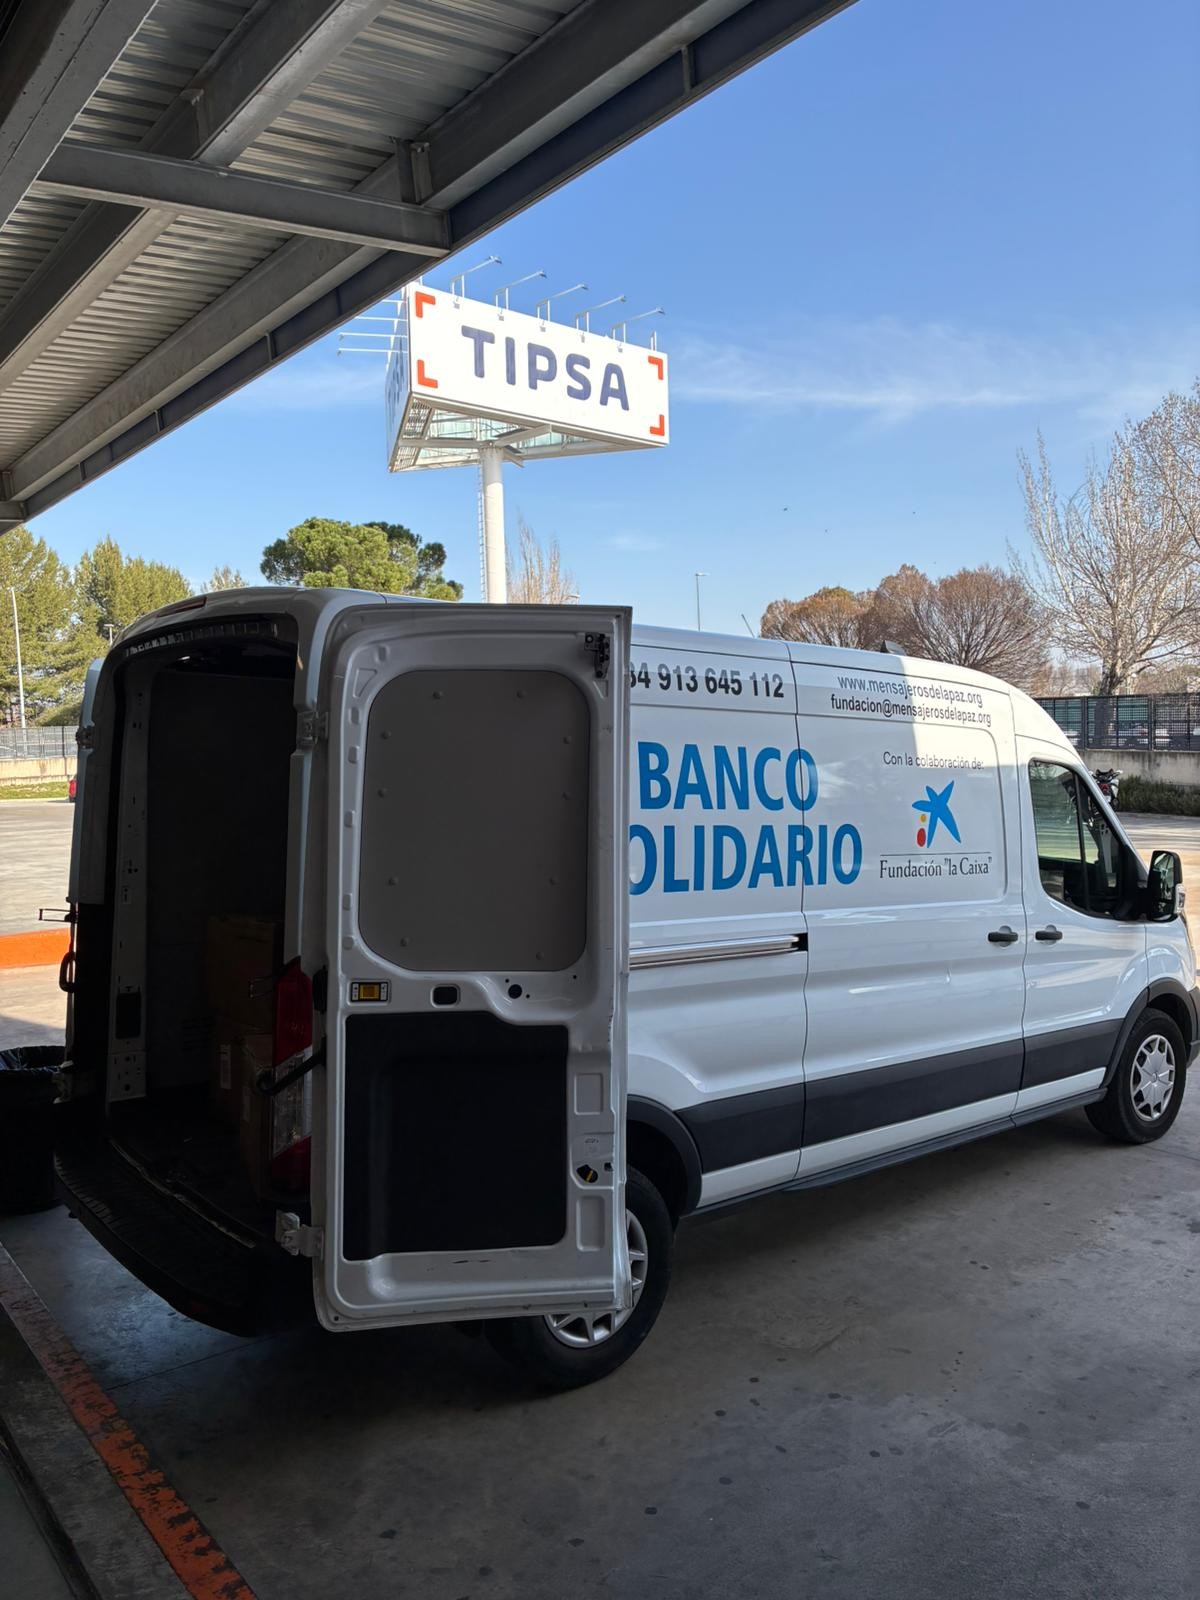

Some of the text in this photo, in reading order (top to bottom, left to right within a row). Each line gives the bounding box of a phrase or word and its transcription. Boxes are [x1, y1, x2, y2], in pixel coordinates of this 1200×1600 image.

[461, 325, 630, 411] TIPSA
[657, 663, 698, 693] 913
[704, 667, 743, 696] 645
[749, 671, 784, 698] 112
[837, 676, 983, 708] www.mensajerosdelapaz.org
[831, 694, 992, 727] fundacion@mensajerosdelapaz.org
[637, 741, 819, 812] BANCO
[883, 751, 985, 770] Con la colaboración de:
[879, 860, 942, 879] Fundación
